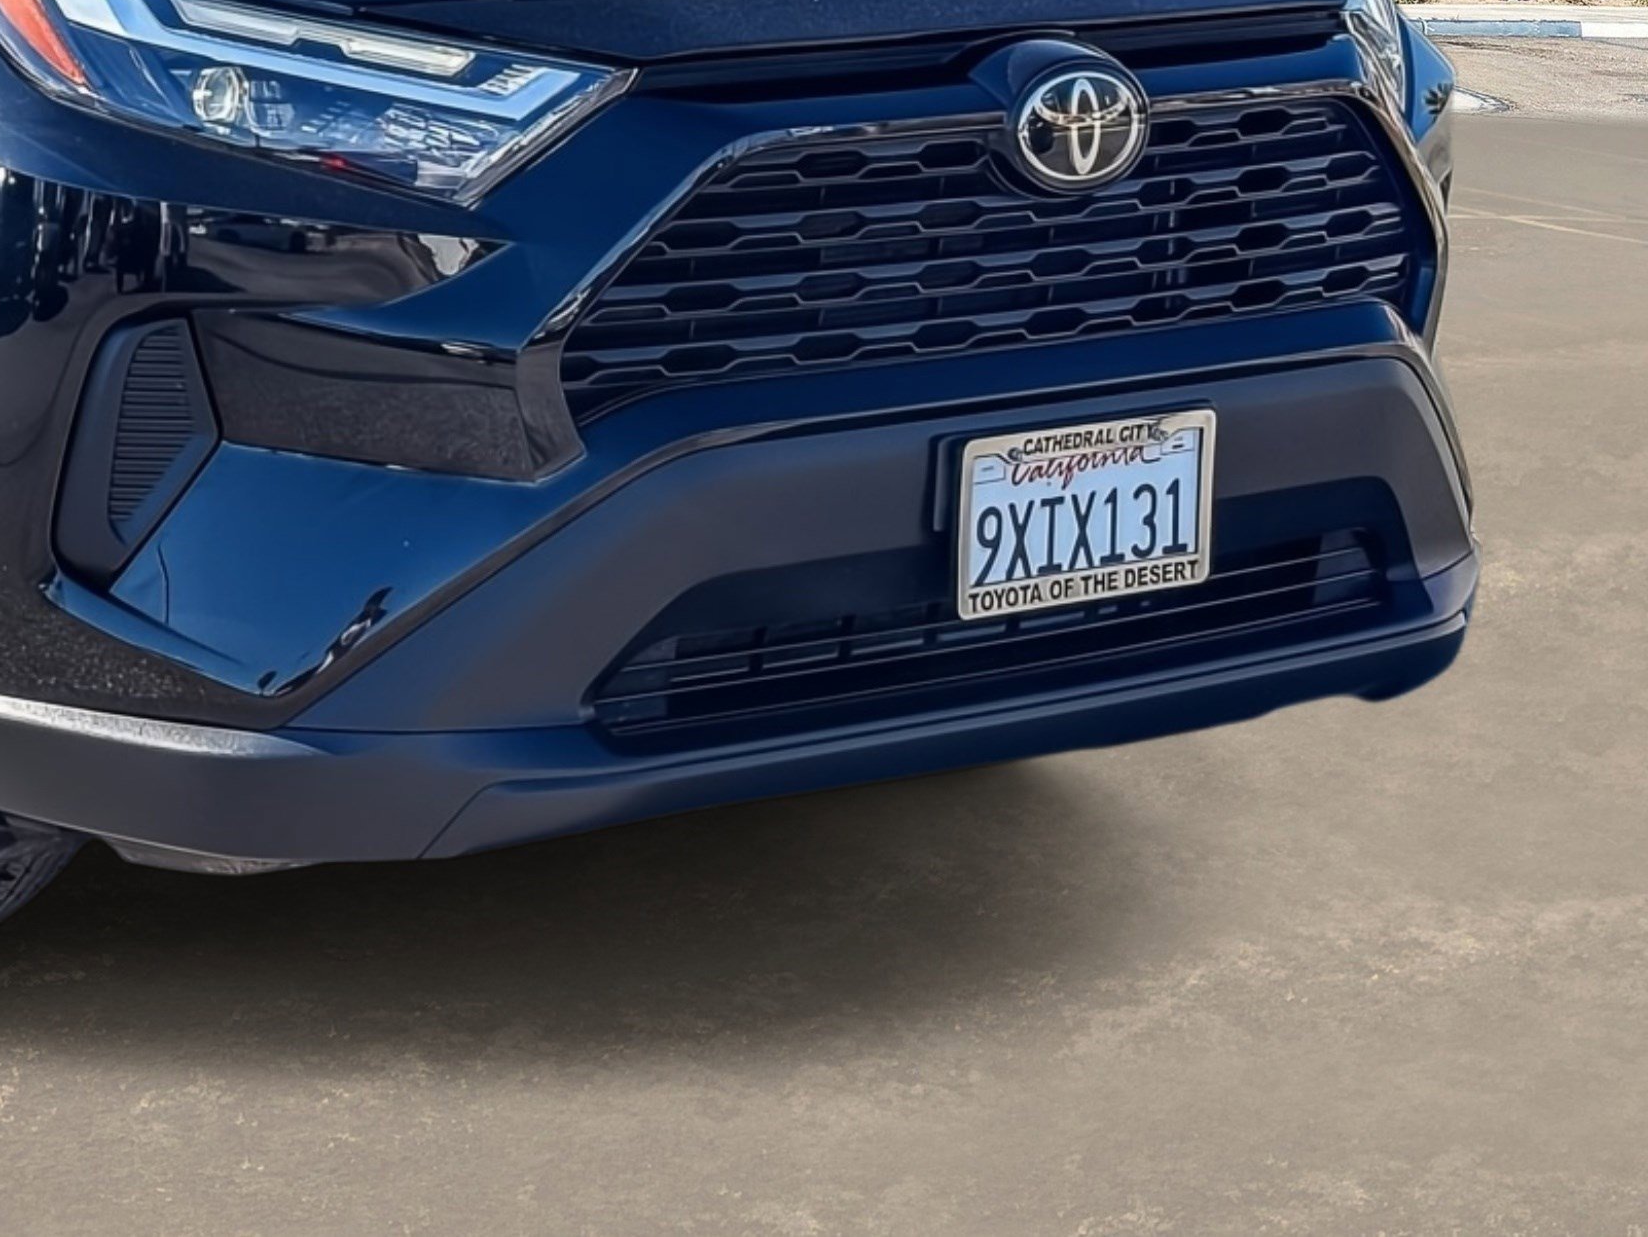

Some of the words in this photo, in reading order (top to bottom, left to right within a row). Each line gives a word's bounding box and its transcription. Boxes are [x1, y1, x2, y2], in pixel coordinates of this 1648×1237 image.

[1023, 427, 1114, 456] CATHEDRAL
[1118, 422, 1160, 443] CITY
[1011, 445, 1161, 490] California
[972, 477, 1189, 588] 9XIX131
[968, 583, 1043, 614] TOYOTA
[1050, 577, 1075, 600] OF
[1080, 570, 1119, 594] THE
[1125, 559, 1200, 589] DESERT
